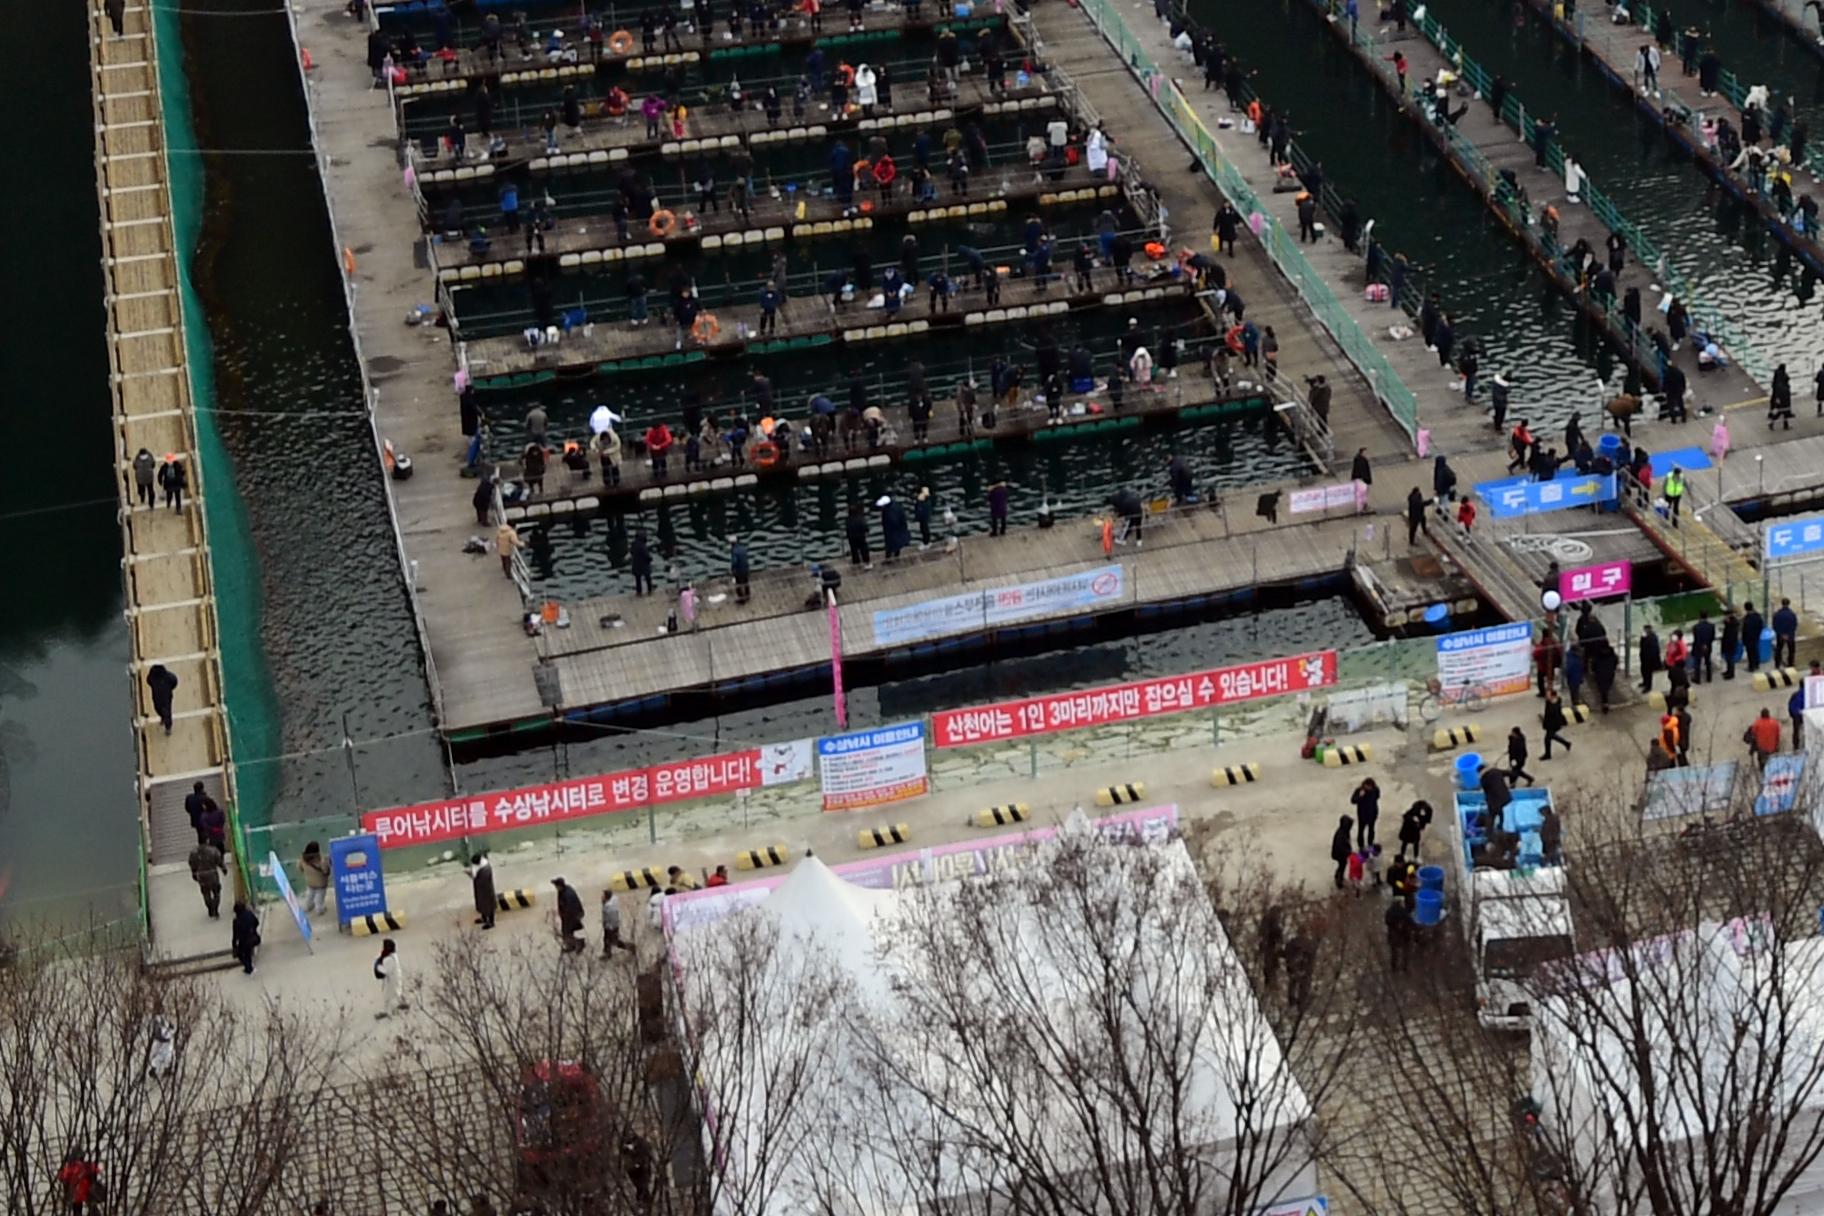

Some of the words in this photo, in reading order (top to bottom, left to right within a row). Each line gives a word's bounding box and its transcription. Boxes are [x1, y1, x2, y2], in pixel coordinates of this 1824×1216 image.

[946, 709, 1012, 744] 산천어는
[1018, 705, 1045, 730] 1인
[1049, 690, 1141, 728] 3마리까지만
[1145, 679, 1194, 710] 잡으실
[1199, 679, 1216, 704] 수
[1221, 662, 1289, 701] 있습니다!
[375, 801, 489, 843] 루어낚시터를
[493, 783, 607, 822] 수상낚시터로
[612, 774, 650, 804] 변경
[655, 757, 753, 796] 운영합니다!
